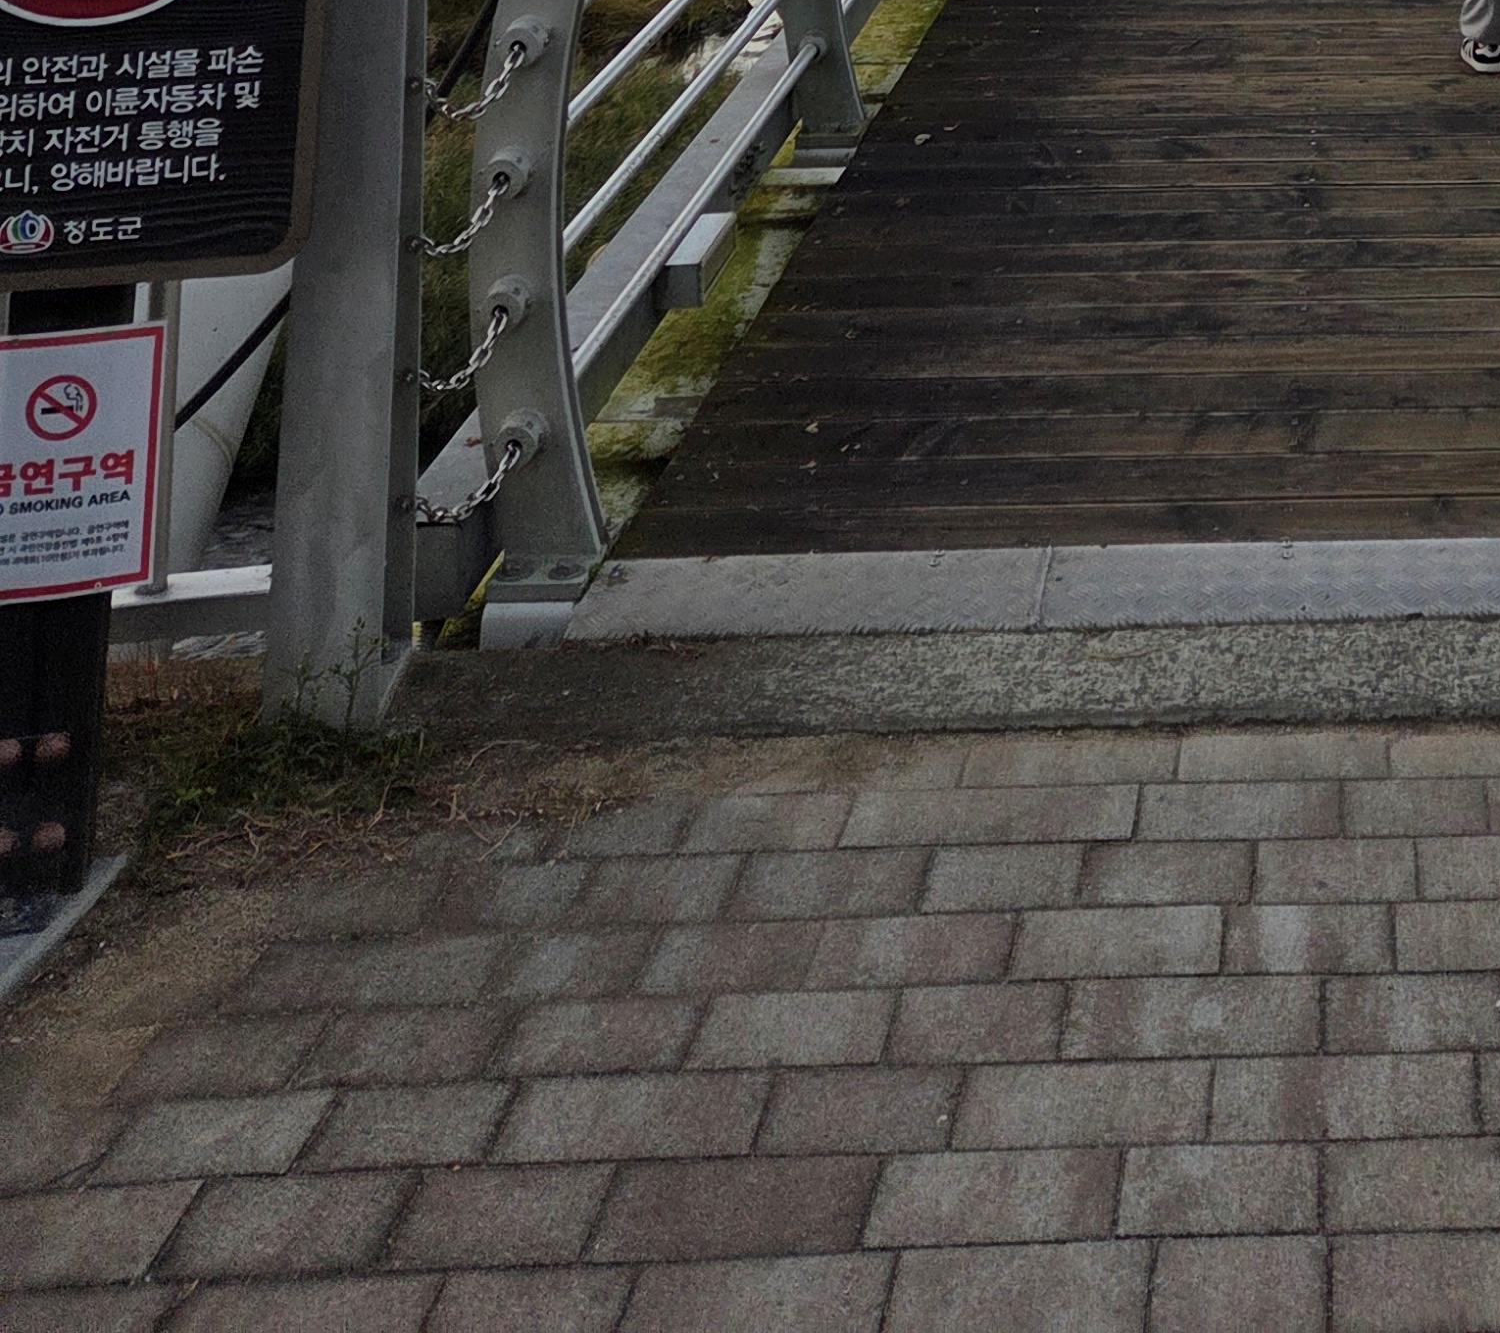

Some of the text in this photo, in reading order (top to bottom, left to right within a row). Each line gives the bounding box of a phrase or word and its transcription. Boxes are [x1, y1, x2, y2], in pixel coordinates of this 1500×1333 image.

[22, 53, 108, 84] 안전과
[115, 48, 201, 80] 시설물
[207, 45, 264, 75] 파손
[86, 82, 226, 117] 이륜자동차
[234, 80, 261, 110] 및
[0, 118, 224, 157] 치 자전거 통행을
[0, 153, 226, 194] 니, 양해바랍니다.
[63, 216, 142, 244] 청도군
[9, 496, 83, 514] SMOKING
[88, 489, 131, 507] AREA
